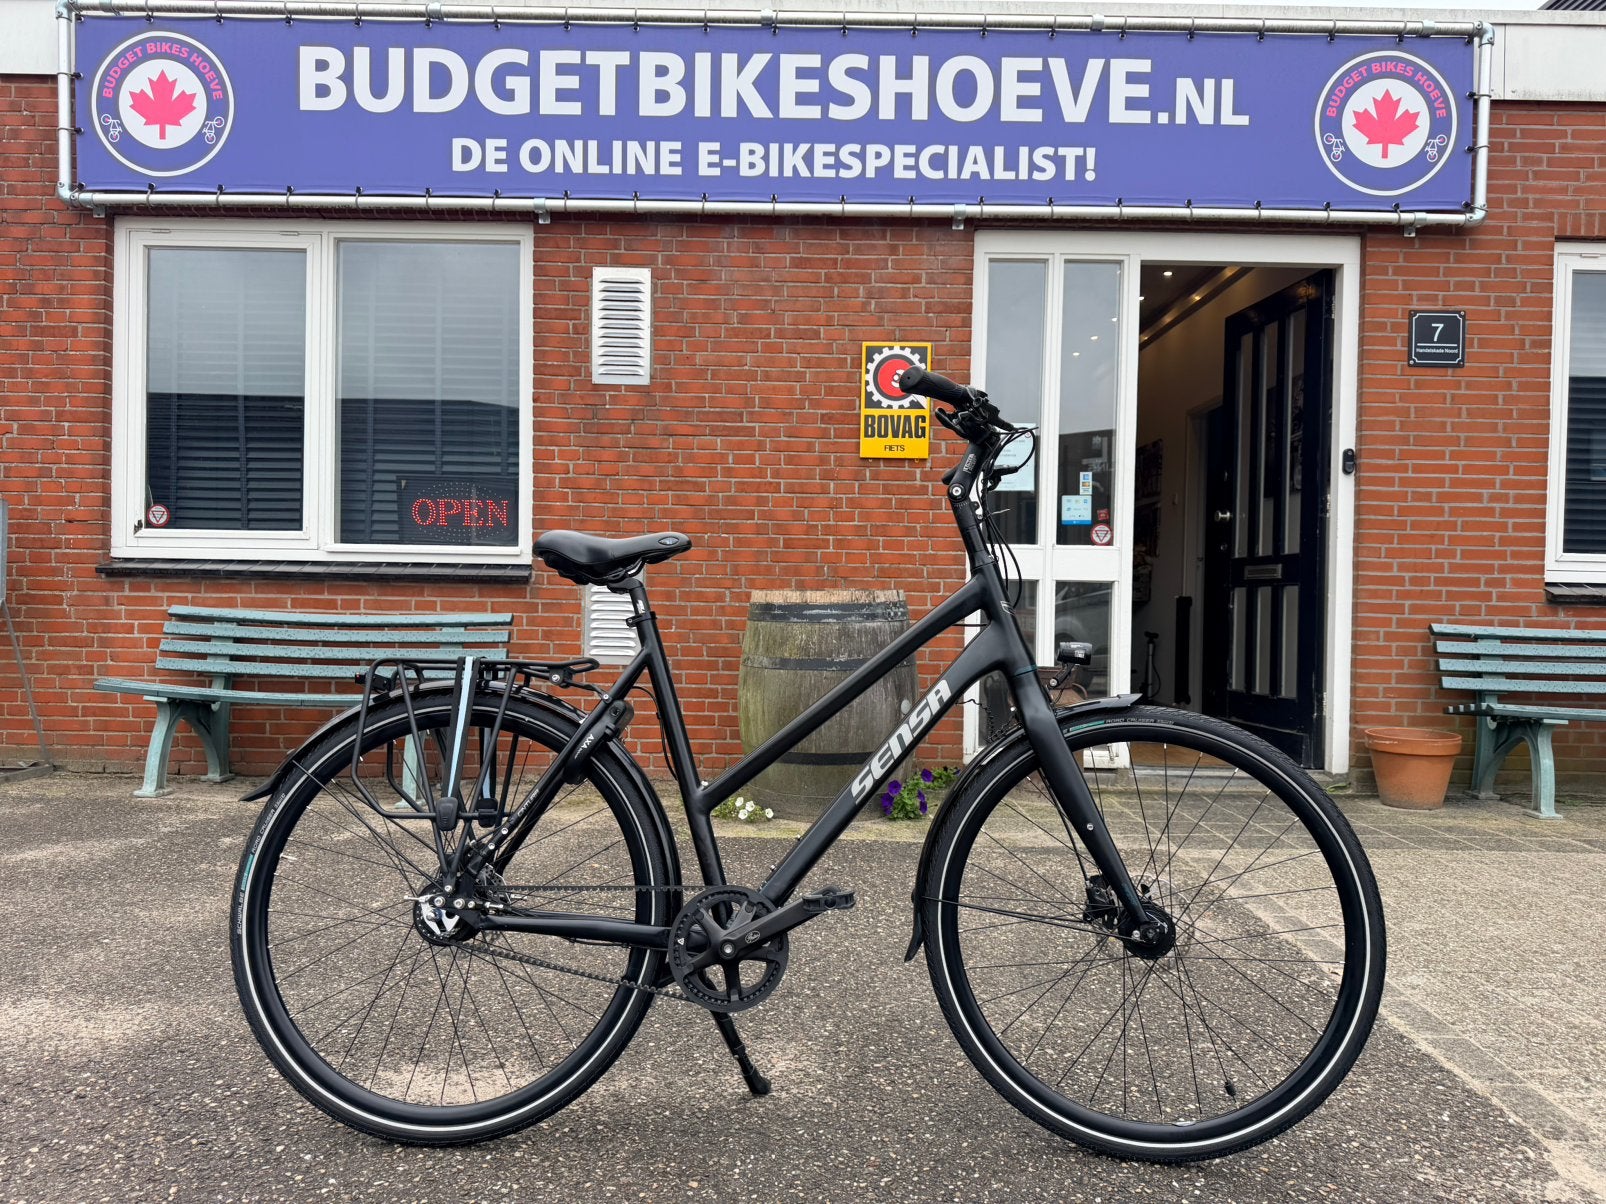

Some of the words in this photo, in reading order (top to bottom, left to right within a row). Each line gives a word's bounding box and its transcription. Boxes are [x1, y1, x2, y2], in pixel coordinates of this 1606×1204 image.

[103, 47, 143, 98] BUDGET
[146, 42, 190, 58] BIKES
[190, 53, 223, 100] HOEVE
[297, 44, 1250, 127] BUDGETBIKESHOEVE.NL
[1326, 66, 1368, 117] BUDGET
[1371, 61, 1415, 77] BIKES
[1415, 72, 1447, 118] HOEVE
[451, 137, 508, 173] DE
[518, 138, 682, 176] ONLINE
[697, 141, 1096, 182] E-BIKESPECIALIST!
[1431, 323, 1444, 342] 7
[863, 414, 926, 438] BOVAG
[884, 444, 905, 452] FIETS
[411, 498, 509, 527] OPEN
[581, 733, 595, 749] AXA
[850, 679, 952, 806] SENSA
